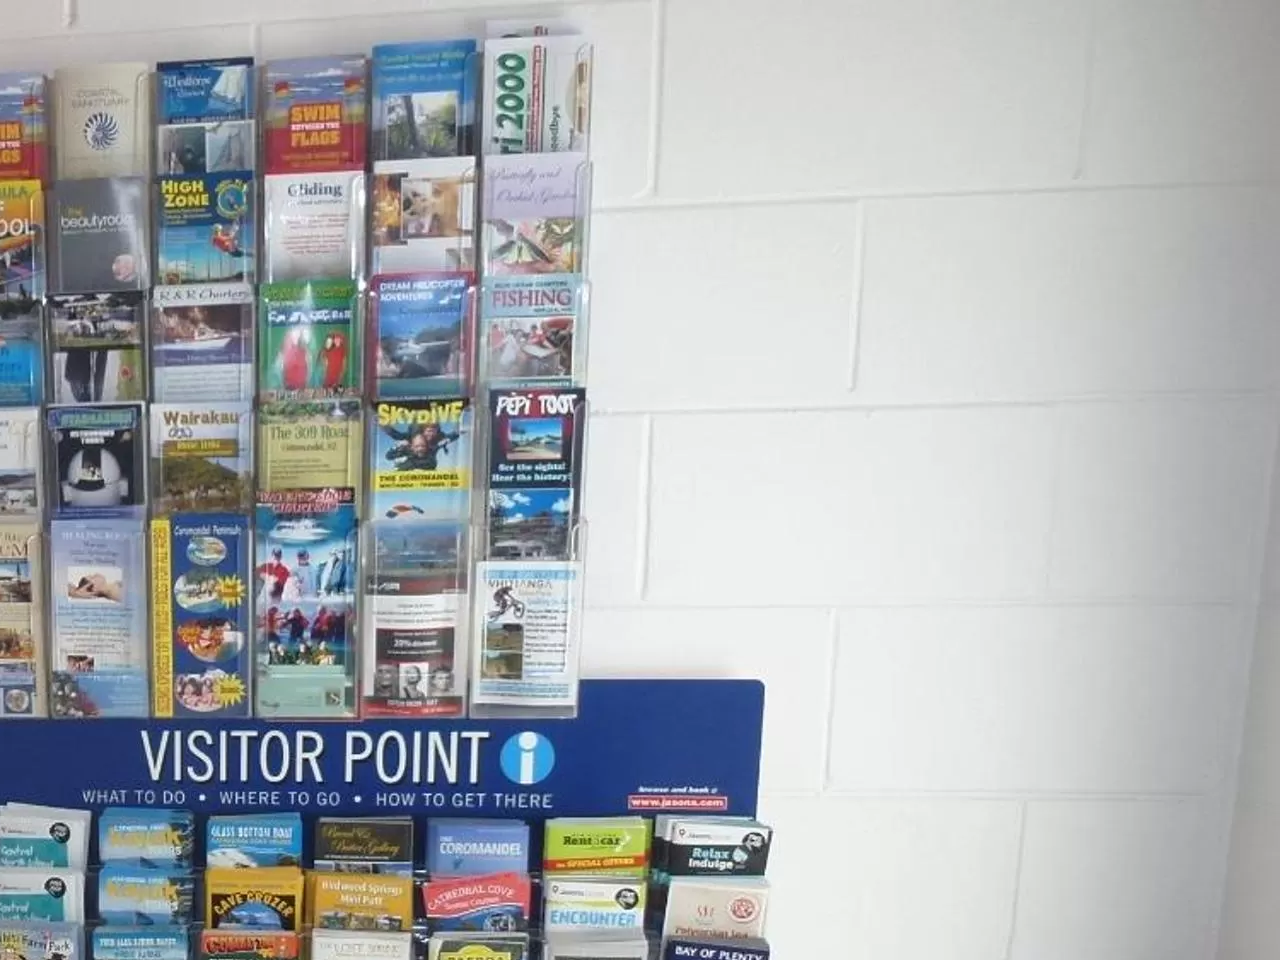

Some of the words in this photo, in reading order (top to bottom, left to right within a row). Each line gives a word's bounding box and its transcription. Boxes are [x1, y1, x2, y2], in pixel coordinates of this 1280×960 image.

[496, 53, 526, 130] 2000
[292, 105, 341, 122] SWIM
[291, 131, 341, 147] FLAGS
[161, 180, 204, 193] HIGH
[287, 182, 343, 197] Gliding
[164, 193, 209, 207] ZONE
[492, 288, 572, 308] FISHING
[538, 394, 578, 414] TOOT
[271, 426, 291, 440] The
[140, 729, 324, 782] VISITOR
[343, 730, 490, 783] POINT
[82, 790, 127, 804] WHAT
[134, 791, 154, 804] TO
[163, 791, 186, 805] DO
[220, 791, 280, 806] WHERE
[289, 792, 308, 806] TO
[316, 792, 341, 806] GO
[376, 793, 416, 807] HOW
[423, 793, 446, 807] TO
[452, 793, 485, 807] GET
[494, 794, 553, 808] THERE
[237, 826, 271, 838] BOTTOM
[562, 834, 592, 846] Rent
[439, 842, 522, 857] COROMANDEL
[691, 847, 730, 858] Relax
[688, 857, 734, 871] Indulge
[367, 881, 403, 895] Springs
[214, 893, 243, 915] CAVE
[246, 890, 295, 917] CRUZER
[427, 885, 485, 910] CATHEDRAL
[488, 884, 515, 899] COVE
[550, 909, 636, 926] ENCOUNTER
[48, 940, 71, 952] Park
[675, 945, 697, 958] BAY
[699, 948, 716, 959] OF
